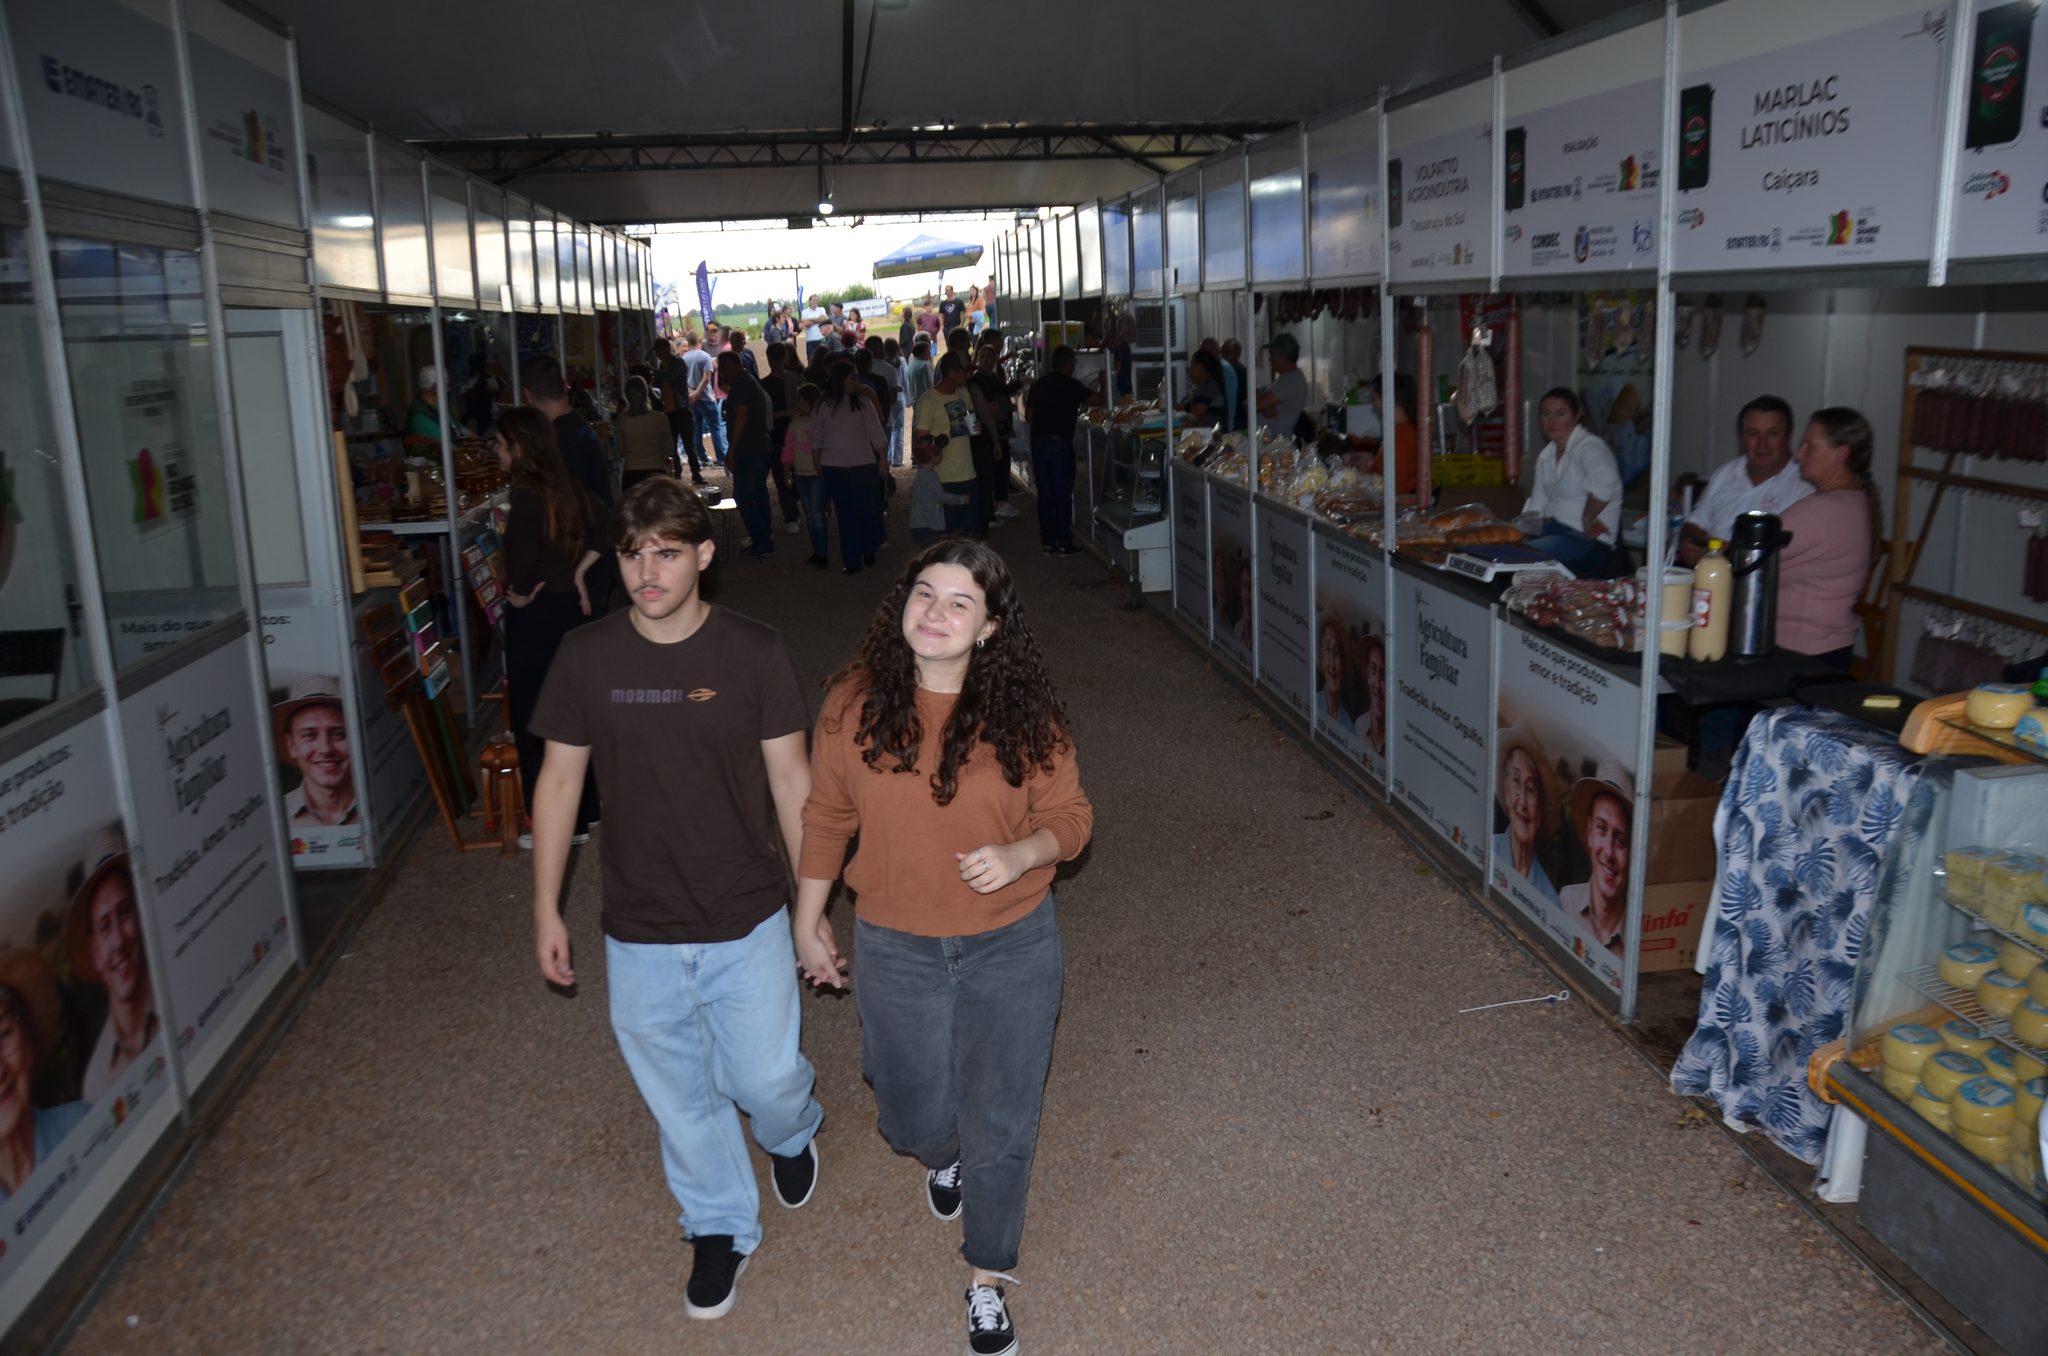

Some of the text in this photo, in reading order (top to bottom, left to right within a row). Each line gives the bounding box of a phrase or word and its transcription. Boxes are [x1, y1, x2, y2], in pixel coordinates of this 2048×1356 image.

[1754, 75, 1838, 116] MARLAC
[1741, 107, 1851, 150] LATICÍNIOS
[1415, 157, 1459, 181] VOLPATTO
[121, 620, 160, 634] Mais
[161, 619, 182, 633] do
[1418, 611, 1468, 660] Agricultura
[1420, 642, 1460, 687] Familiar
[1521, 632, 1611, 689] Mais do que produtos:
[1528, 659, 1599, 706] amor e tradição
[8, 779, 65, 827] tradição
